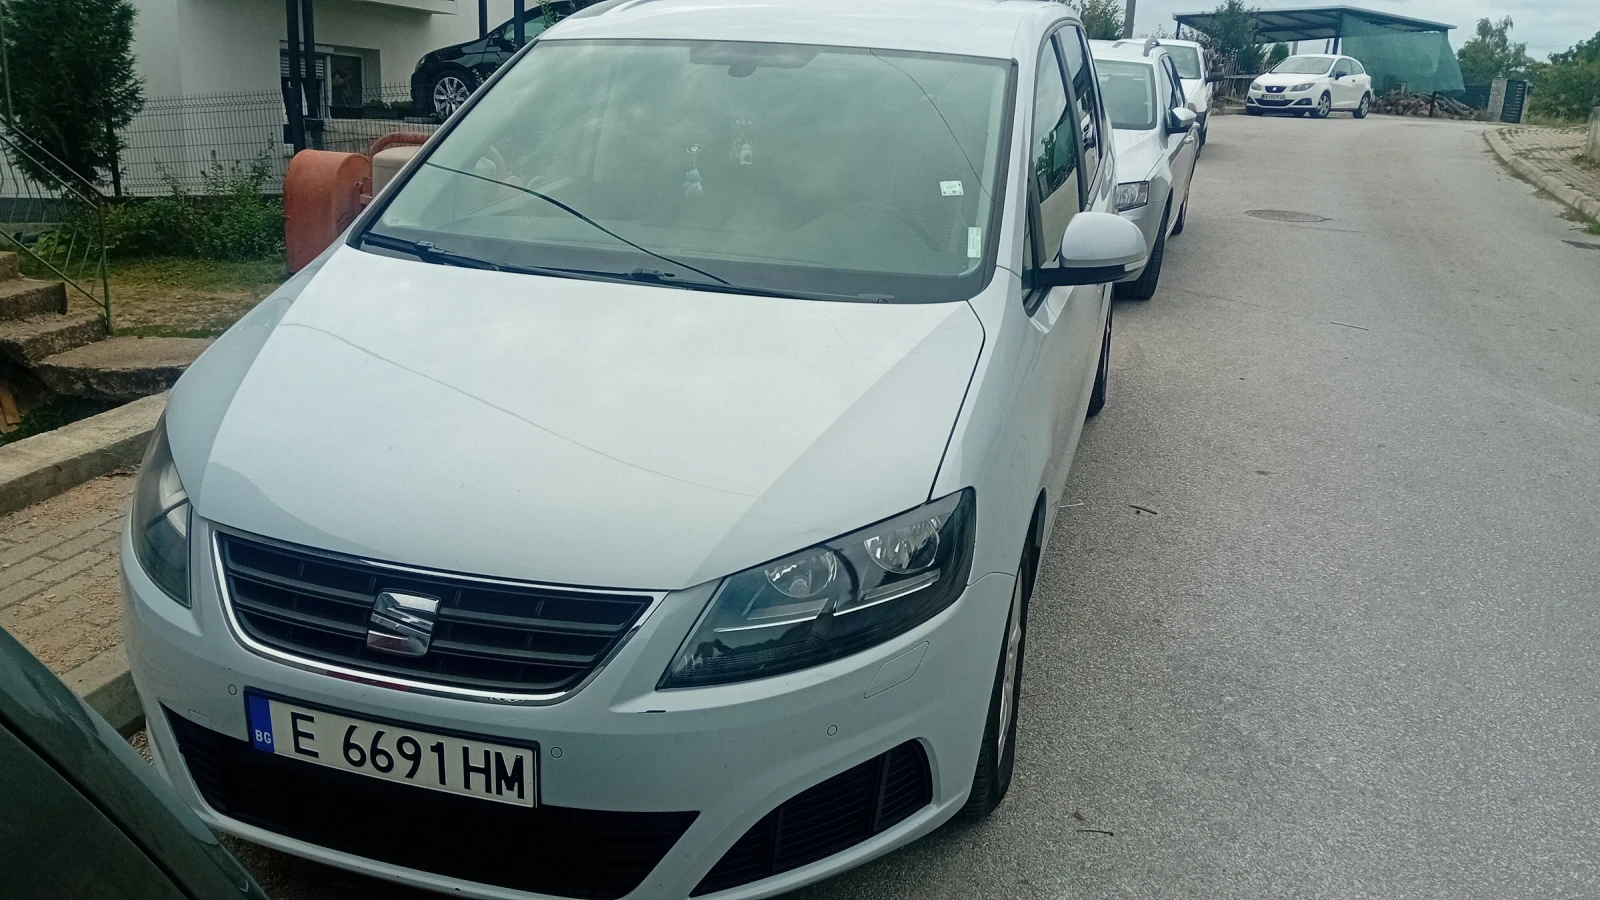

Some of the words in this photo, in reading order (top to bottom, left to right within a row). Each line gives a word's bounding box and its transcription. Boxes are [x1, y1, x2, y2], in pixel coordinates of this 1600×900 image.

[255, 729, 271, 744] BG
[291, 711, 319, 758] E
[342, 725, 447, 786] 6691
[462, 745, 525, 799] HM
